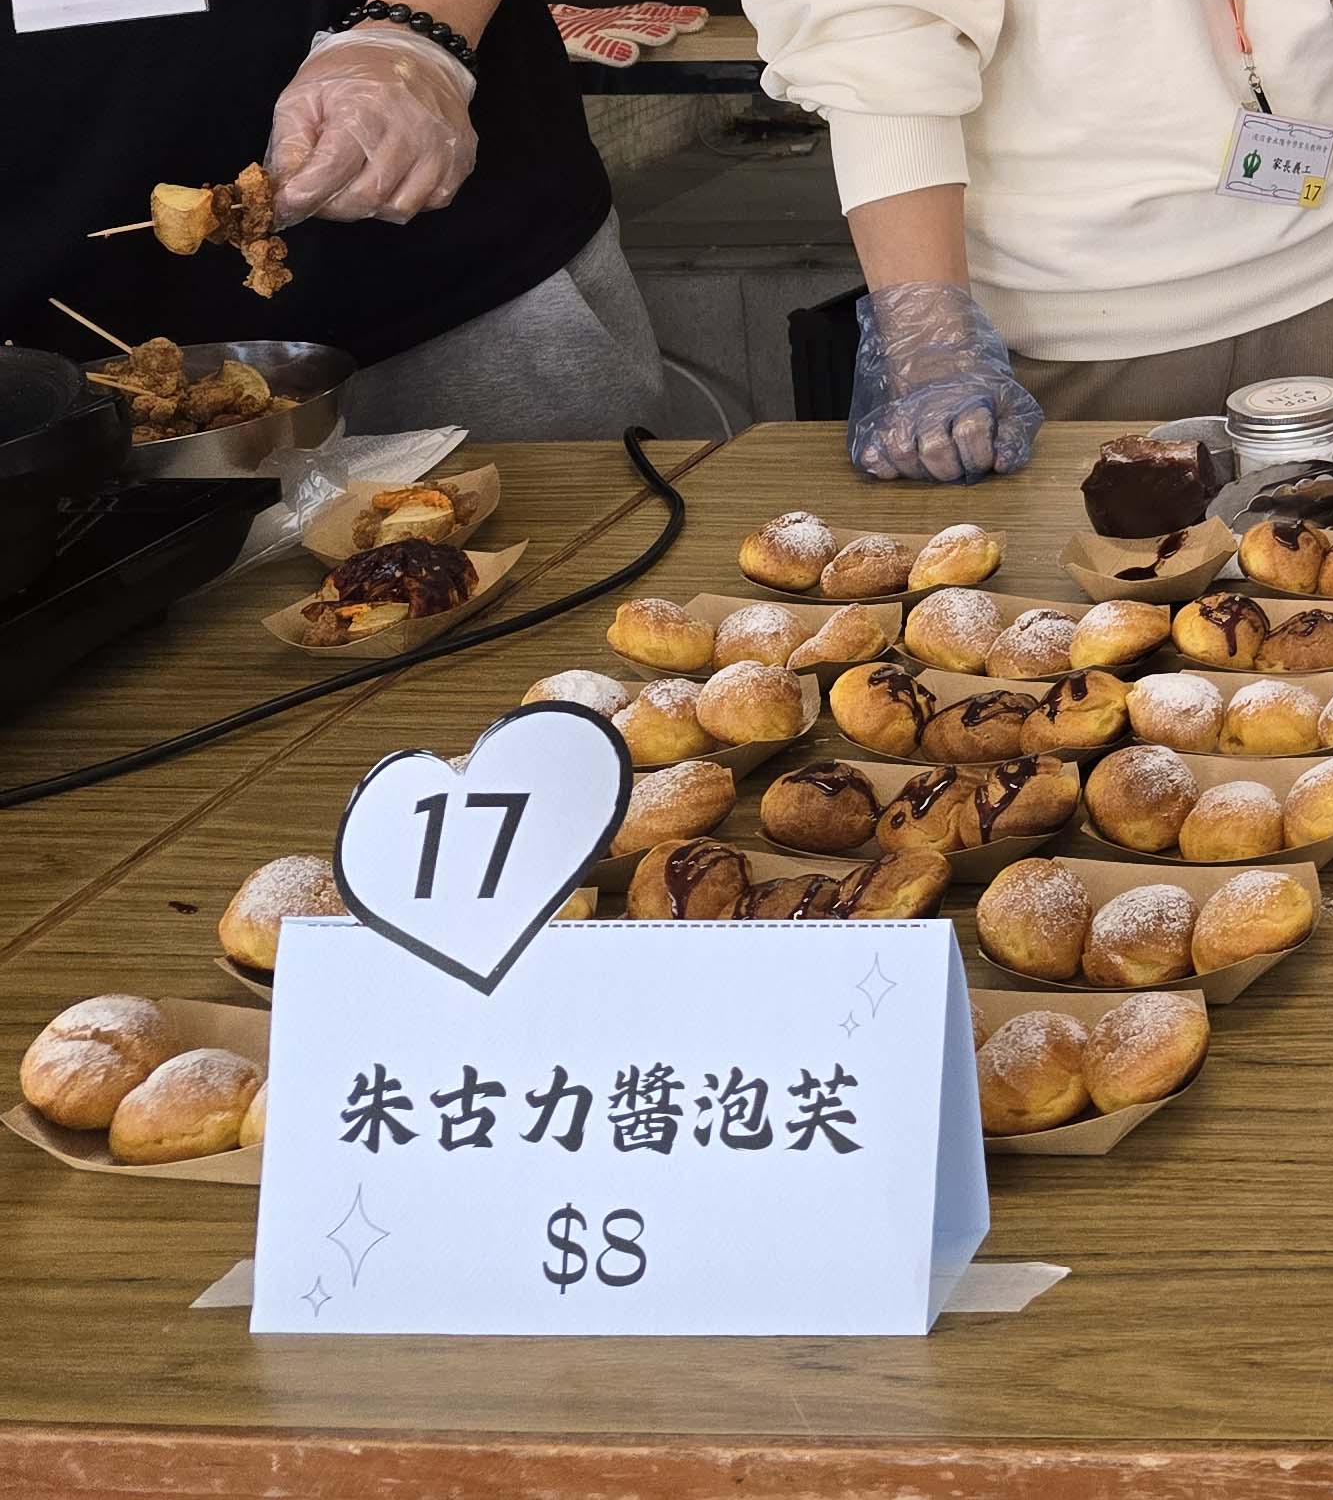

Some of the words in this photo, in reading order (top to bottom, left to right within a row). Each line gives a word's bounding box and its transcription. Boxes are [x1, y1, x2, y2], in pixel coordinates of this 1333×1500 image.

[1272, 157, 1311, 175] 家長義工
[1303, 184, 1322, 201] 17
[413, 792, 531, 900] 17
[339, 1062, 864, 1156] 朱古力醬泡芙
[543, 1202, 648, 1295] $8
